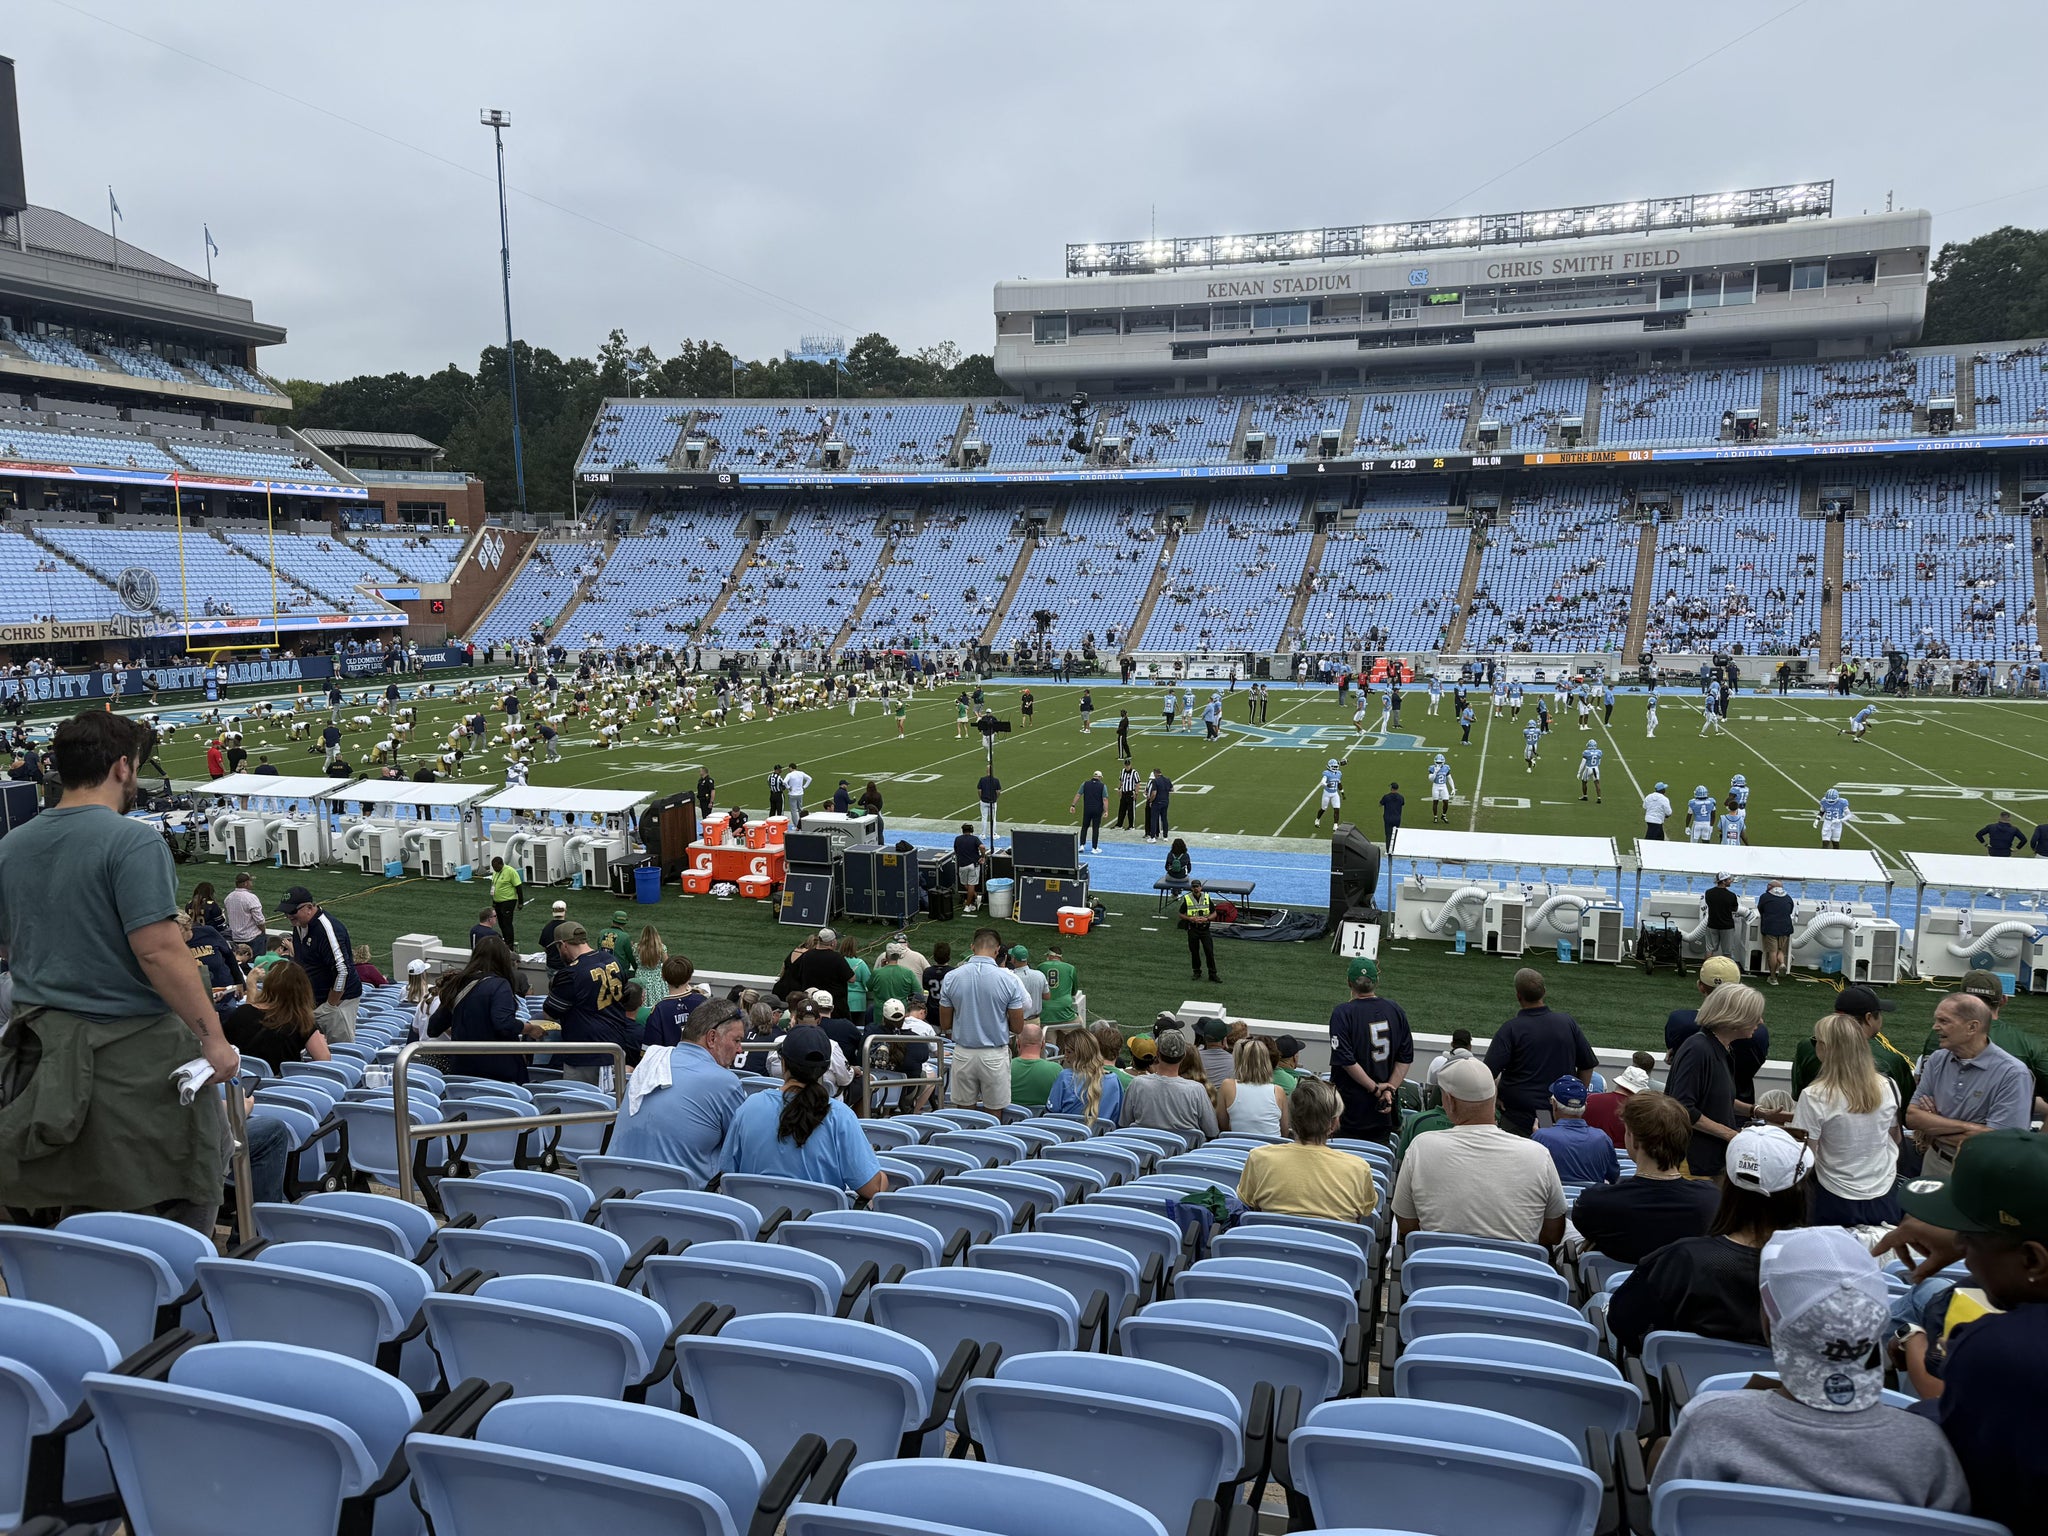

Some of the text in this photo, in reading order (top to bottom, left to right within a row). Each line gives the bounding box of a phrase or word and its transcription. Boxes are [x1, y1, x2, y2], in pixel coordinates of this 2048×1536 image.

[1487, 249, 1680, 279] CHRIS SMITH FIELD
[1207, 274, 1351, 298] KENAN STADIUM
[1813, 445, 1874, 456] CAROLINA
[1433, 458, 1445, 468] 25
[1472, 456, 1501, 466] BALL ON
[1536, 451, 1649, 464] 0 NOTRE DAME TOL 3
[1317, 464, 1325, 473] &
[1361, 462, 1374, 471] 1ST
[1390, 459, 1416, 470] 41:20
[1192, 468, 1198, 477] 3
[1208, 466, 1255, 477] CAROLINA
[1270, 465, 1276, 474] 0
[583, 474, 609, 482] 11:25 AM
[111, 613, 179, 638] Allstate
[2, 627, 46, 641] CHRIS
[52, 625, 95, 639] SMITH
[0, 673, 91, 701] ERSITY
[227, 659, 302, 684] AROLINA
[1438, 774, 1444, 784] 2
[1700, 805, 1708, 817] 4
[1825, 810, 1840, 820] 23
[705, 825, 713, 835] G
[747, 828, 755, 838] G
[769, 825, 777, 835] G
[831, 835, 847, 844] CC
[696, 853, 713, 873] G
[750, 857, 767, 876] G
[687, 878, 696, 888] G
[746, 885, 754, 894] G
[1065, 917, 1075, 928] G
[1353, 930, 1365, 950] 11
[590, 961, 624, 1011] 26
[928, 979, 943, 1000] 2
[1369, 1020, 1390, 1063] 5
[1738, 1161, 1760, 1172] DAME
